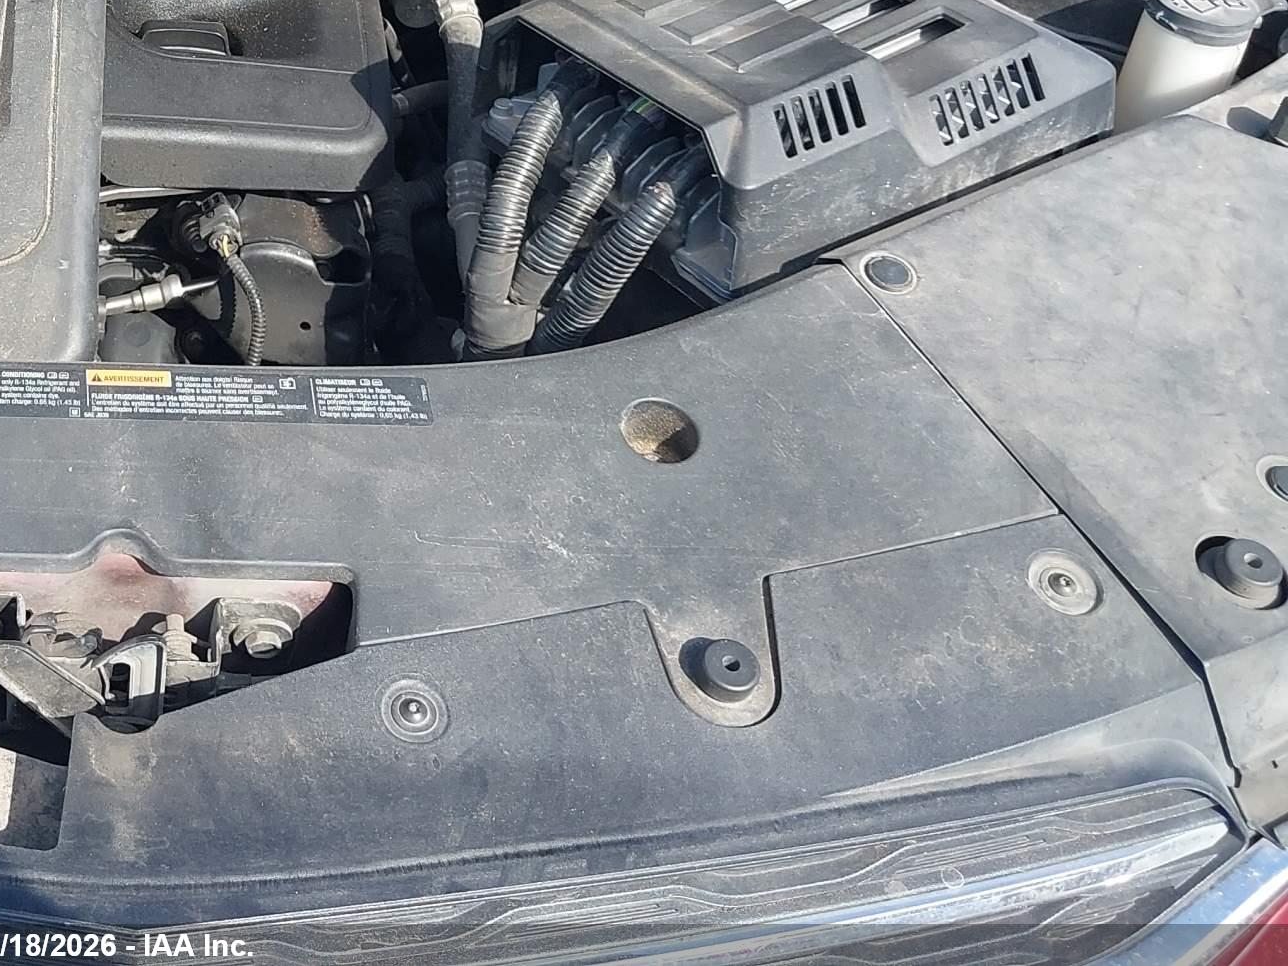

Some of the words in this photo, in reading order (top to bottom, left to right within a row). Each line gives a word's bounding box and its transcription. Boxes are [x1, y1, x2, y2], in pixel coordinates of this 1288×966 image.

[1, 378, 13, 386] only
[104, 375, 164, 383] AVERTISSEMENT
[315, 378, 356, 386] CLIMATISEUR
